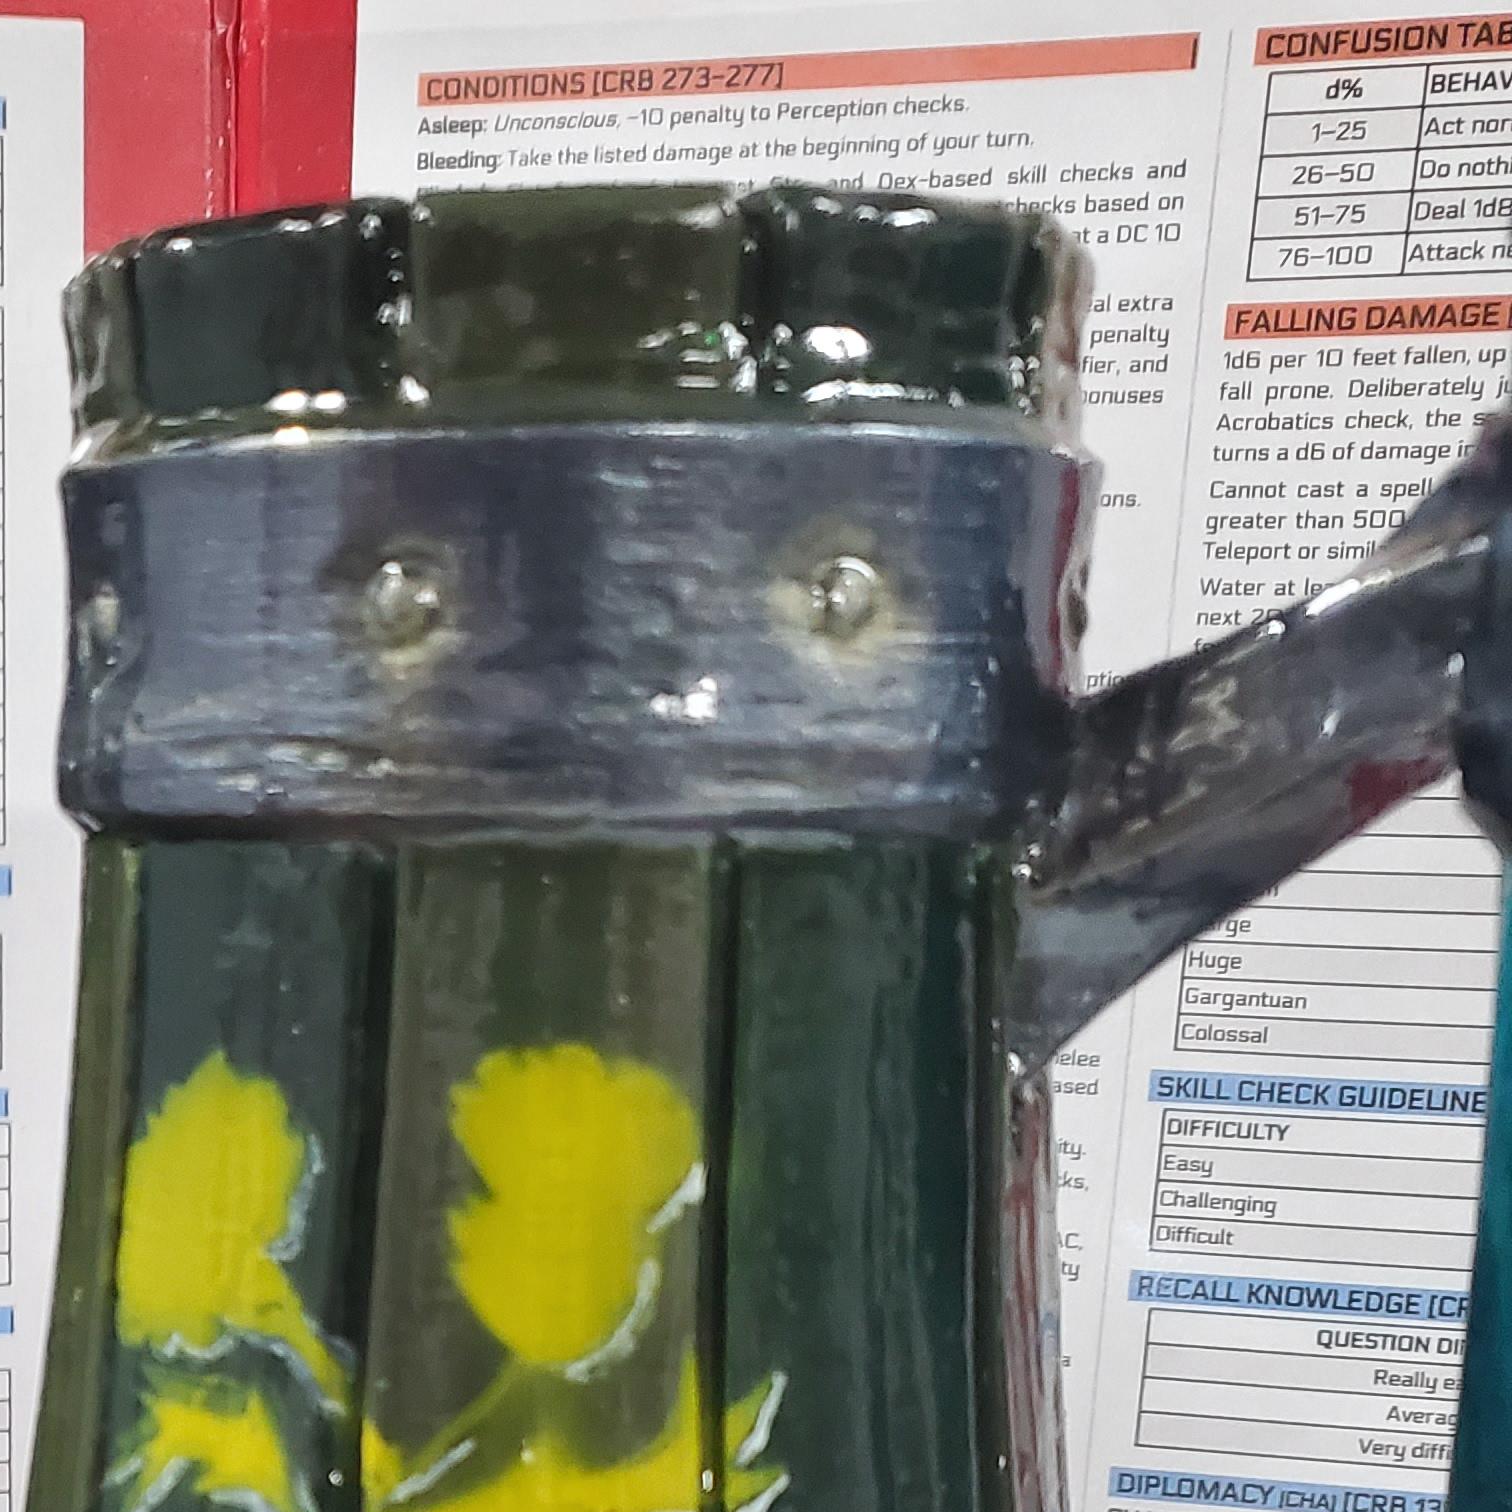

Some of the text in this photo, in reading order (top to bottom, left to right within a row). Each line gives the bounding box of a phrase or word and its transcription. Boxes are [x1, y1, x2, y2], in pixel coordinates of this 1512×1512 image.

[1266, 24, 1448, 58] CONFUSION
[427, 71, 584, 102] CONDITIONS
[1326, 77, 1363, 101] d%
[418, 115, 487, 139] Asleep:
[495, 111, 620, 133] Unconscious,
[670, 105, 744, 131] penalty
[777, 98, 887, 124] Perception
[893, 94, 968, 115] checks.
[417, 130, 1033, 174] Bleeding: Take the listed damage the beginning your turn.
[1236, 301, 1501, 335] FALLING DAMAGE
[1224, 345, 1506, 375] 1d6 per 10 feet fallen, up
[1220, 376, 1484, 407] fall prone. Deliberately
[1216, 407, 1461, 431] Acrobatics check, the
[1210, 477, 1433, 501] Cannot cast spell
[1206, 512, 1286, 535] greater
[1296, 509, 1343, 530] than
[1189, 950, 1242, 974] Huge
[1185, 987, 1306, 1011] Gargantuan
[1181, 1024, 1268, 1044] Colossal
[1157, 1076, 1331, 1105] SKILL CHECK
[1167, 1117, 1290, 1141] DIFFICULTY
[1163, 1155, 1213, 1178] Easy
[1159, 1189, 1276, 1218] Challenging
[1156, 1225, 1233, 1246] Difficult
[1138, 1277, 1421, 1315] RECALL KNOWLEDGE
[1117, 1472, 1275, 1505] DIPLOMACY
